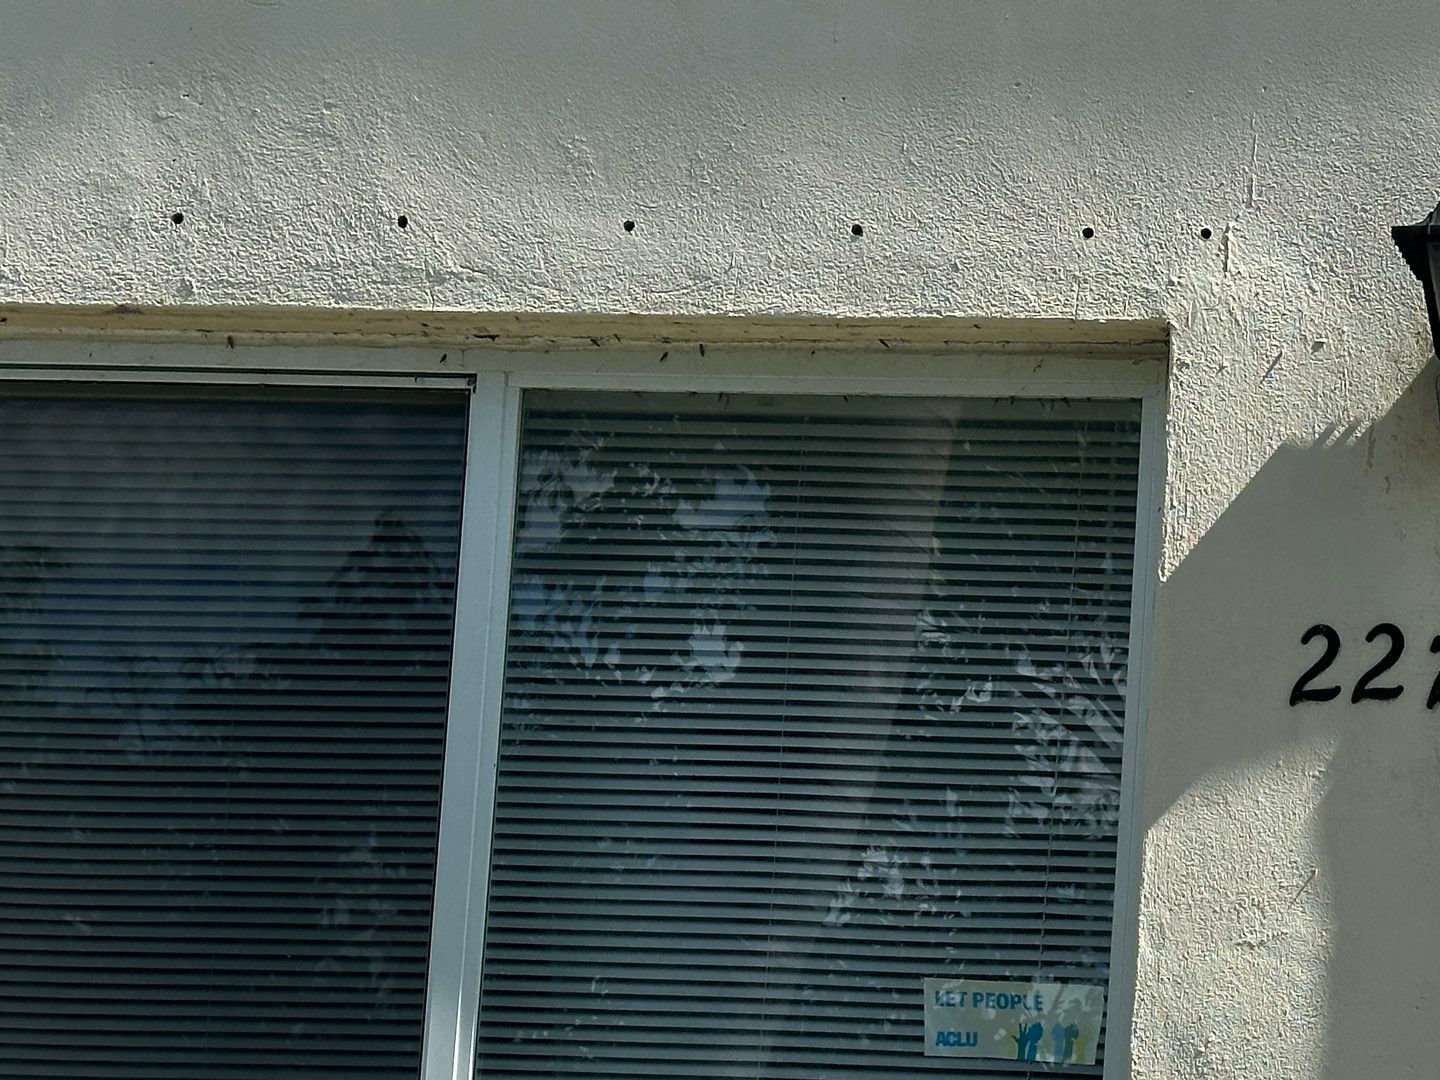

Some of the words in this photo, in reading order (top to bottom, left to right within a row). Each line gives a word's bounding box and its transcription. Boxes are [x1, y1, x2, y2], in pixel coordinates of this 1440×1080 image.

[935, 990, 967, 1008] LET
[972, 991, 1043, 1012] PEOPLE
[935, 1030, 978, 1047] ACLU
